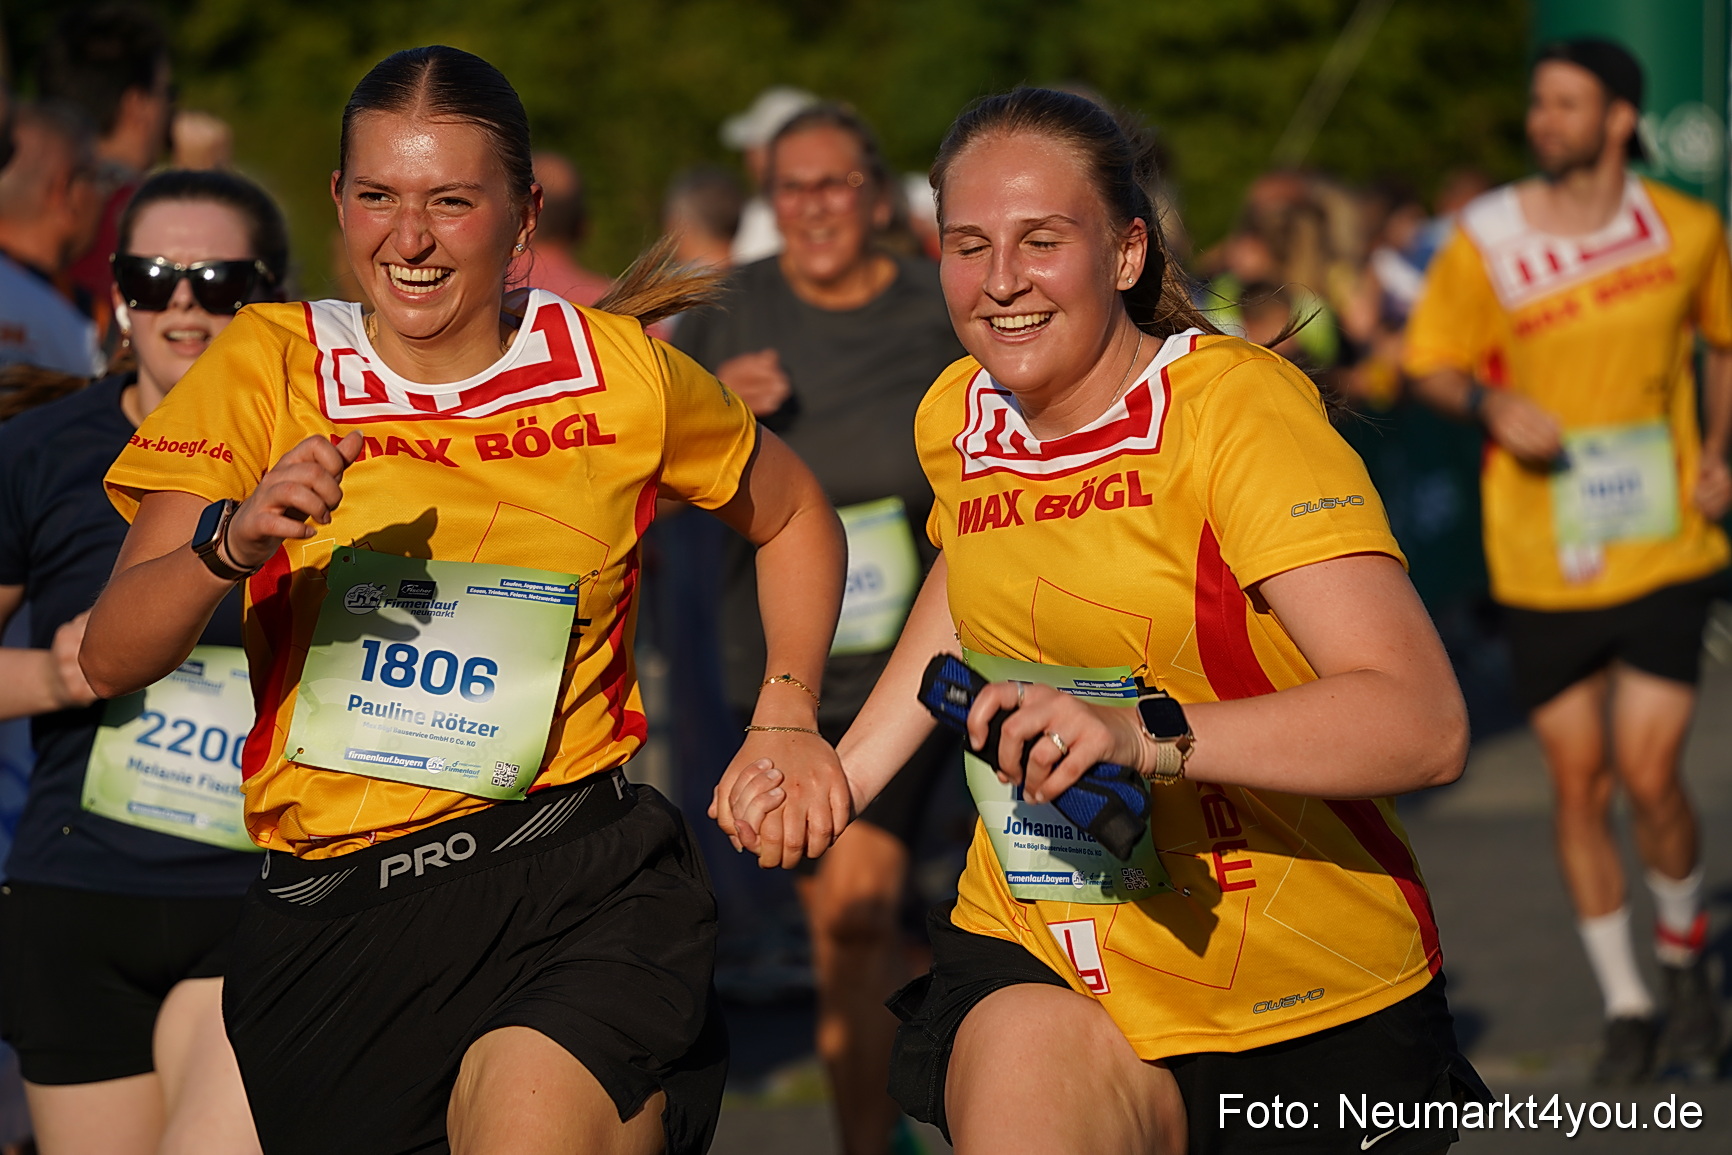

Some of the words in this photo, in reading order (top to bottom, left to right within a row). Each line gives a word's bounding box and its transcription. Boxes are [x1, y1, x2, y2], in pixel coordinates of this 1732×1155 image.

[475, 413, 616, 462] BÖGL
[957, 489, 1024, 537] MAX
[1034, 470, 1153, 521] BÖGL
[383, 599, 459, 610] Firmenlauf
[410, 609, 455, 618] neumarkt
[361, 639, 498, 703] 1806
[347, 694, 427, 726] Pauline
[431, 710, 499, 738] Rötzer
[393, 727, 428, 739] Bauservice
[429, 733, 449, 743] GmbH
[455, 738, 465, 746] Co.
[127, 757, 192, 784] Melanie
[348, 751, 423, 767] firmenlauf.bayern
[1003, 816, 1073, 840] Johanna
[1027, 843, 1039, 851] Bögl
[379, 831, 477, 890] PRO
[1008, 874, 1070, 885] firmenlauf.bayern
